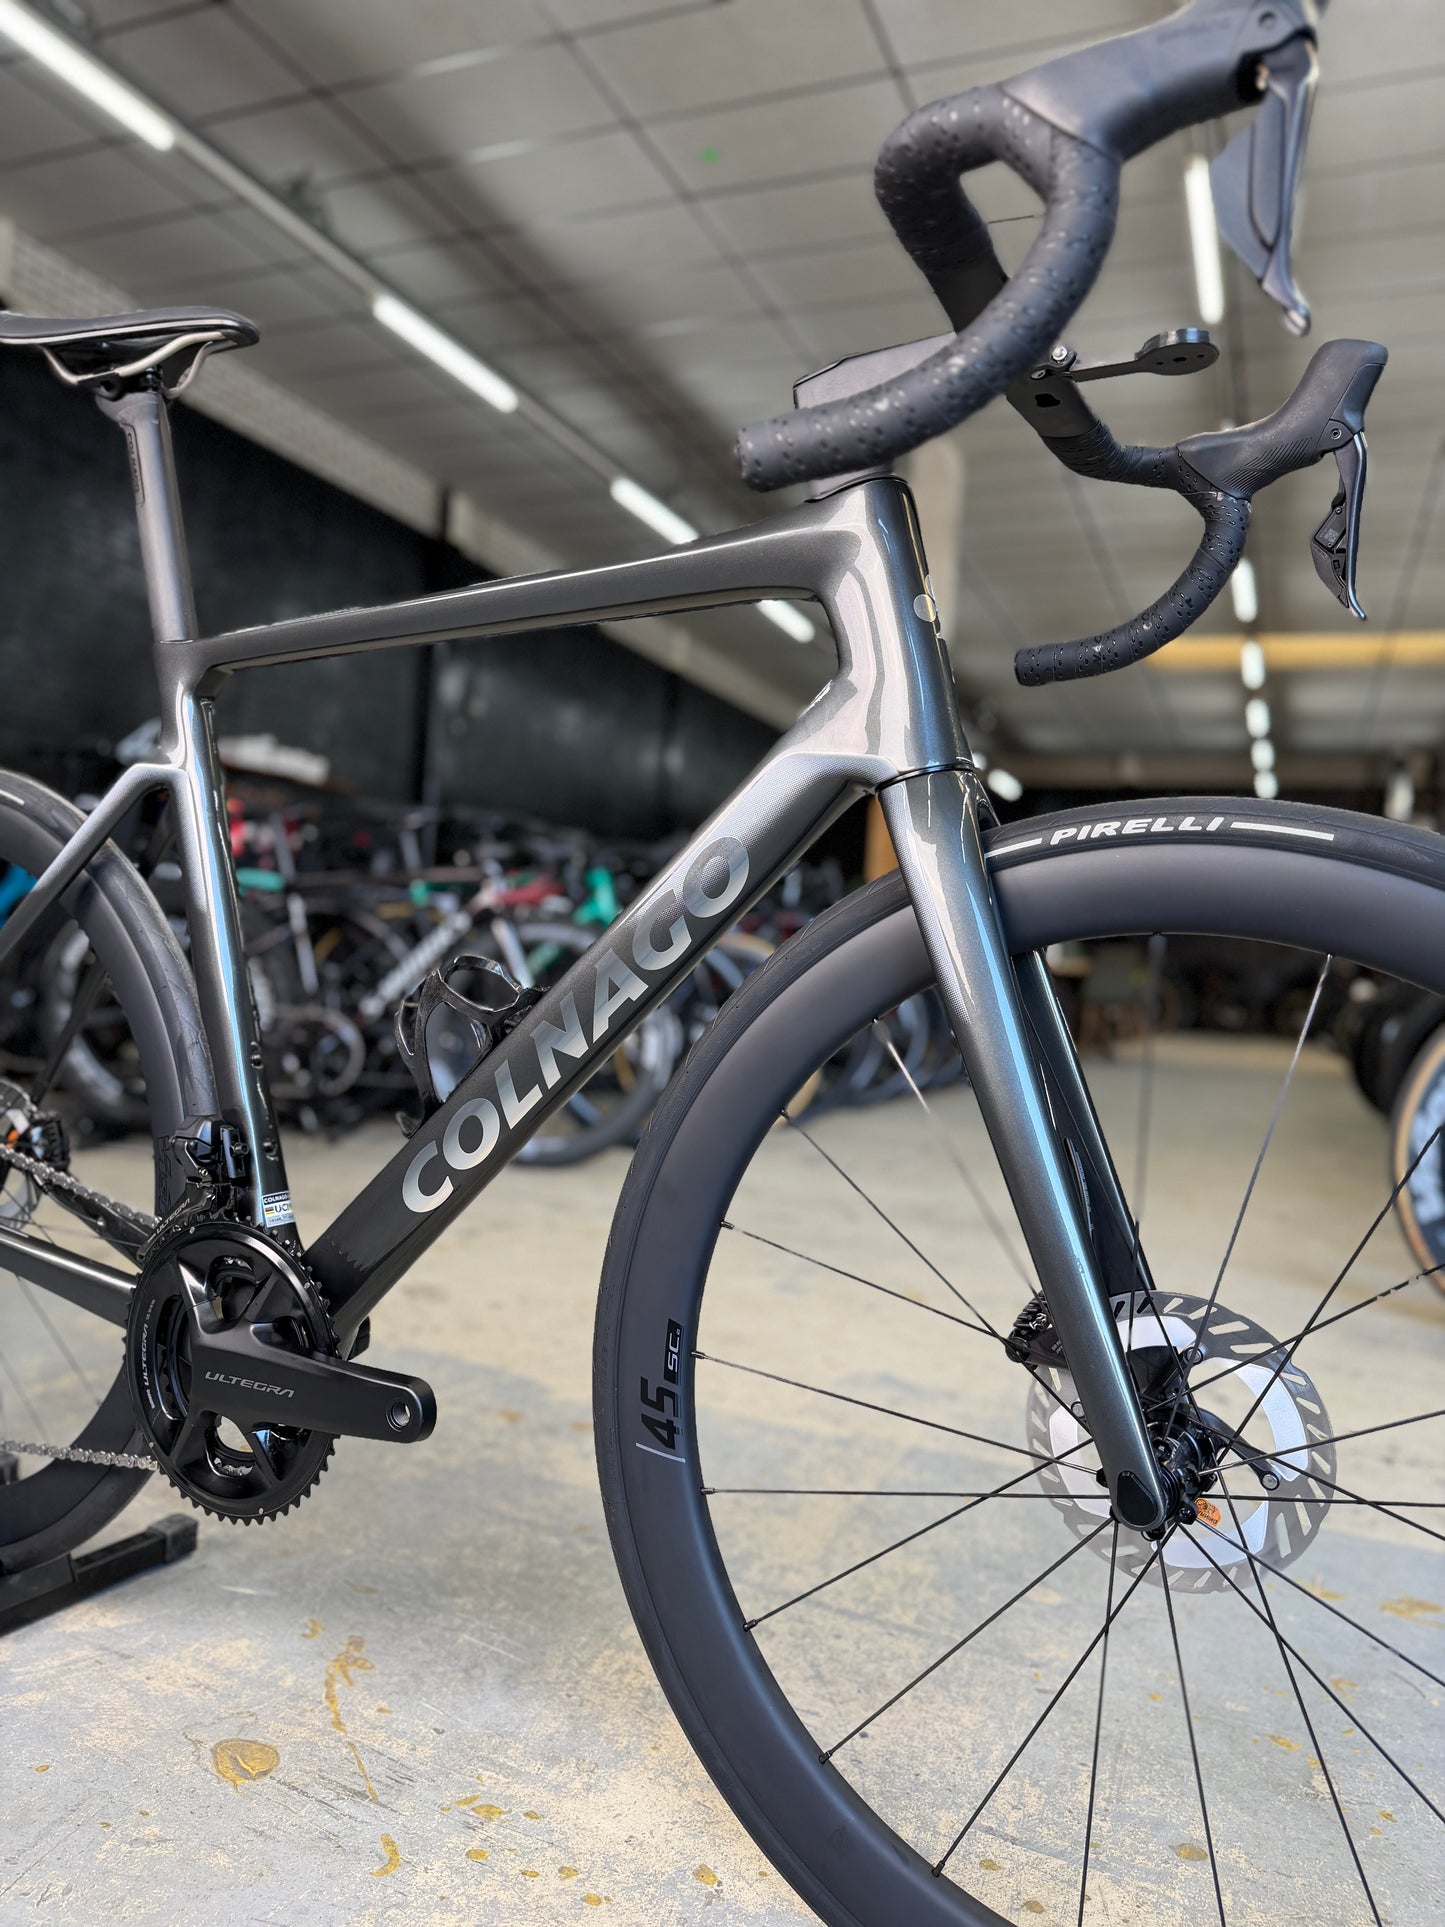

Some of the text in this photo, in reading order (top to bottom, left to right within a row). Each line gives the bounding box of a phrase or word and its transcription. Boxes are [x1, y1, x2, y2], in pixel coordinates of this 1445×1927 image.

[1049, 816, 1225, 846] PIRELLI
[402, 836, 750, 1213] COLNAGO
[205, 1371, 295, 1398] ULTEGRA
[640, 1332, 680, 1450] 45 SC
